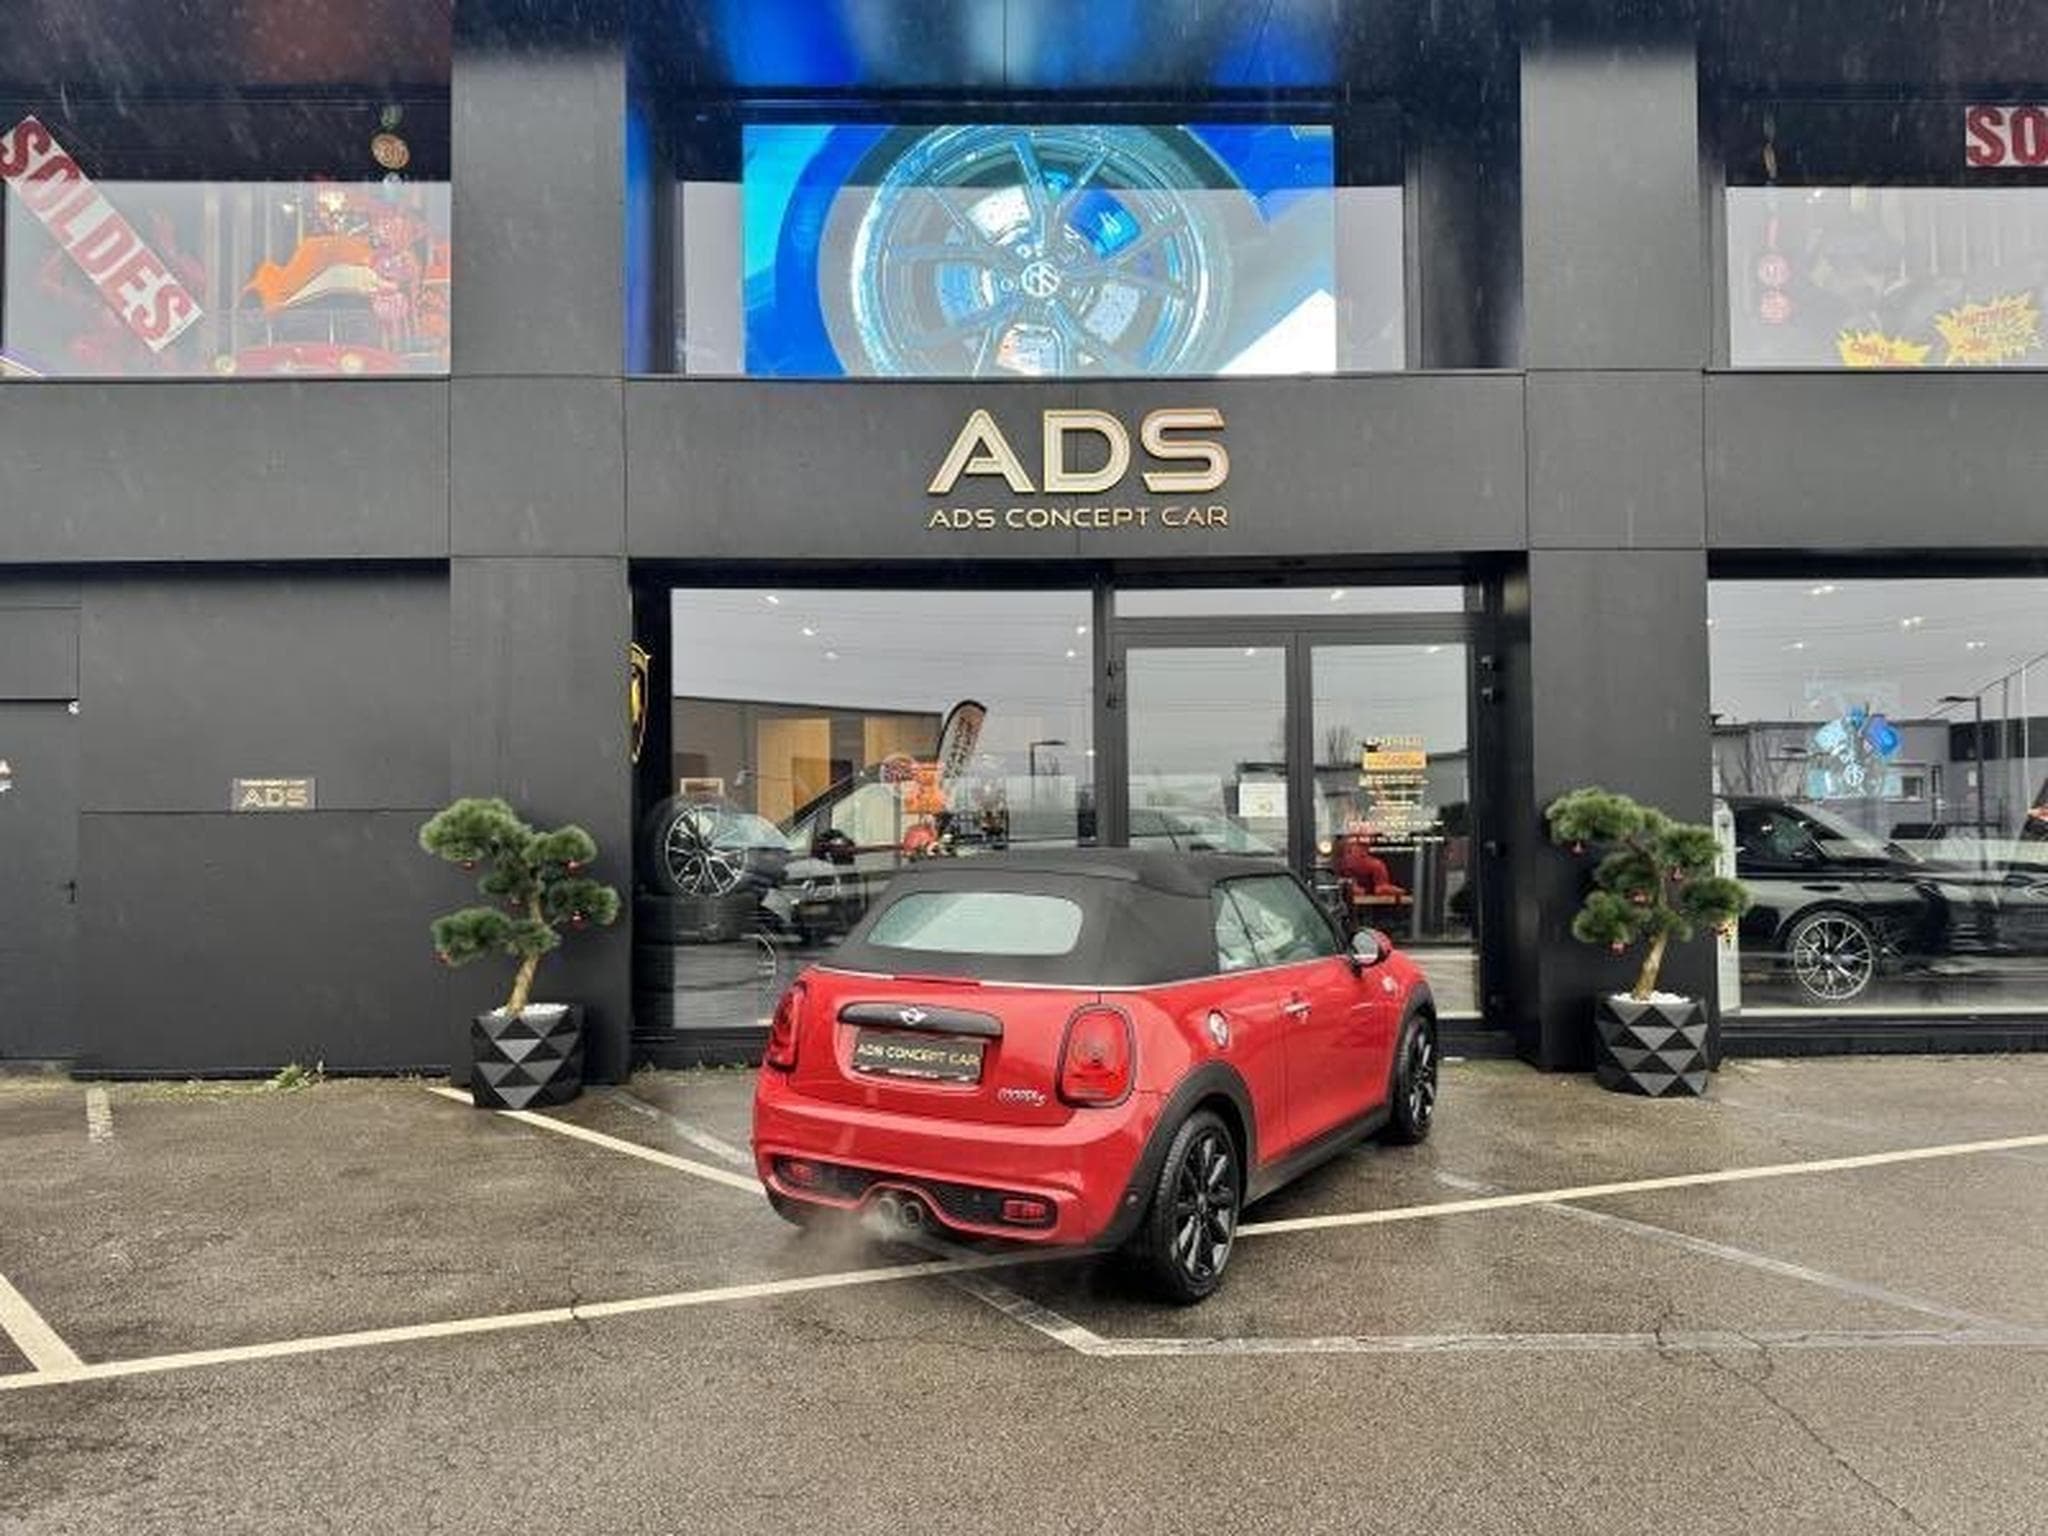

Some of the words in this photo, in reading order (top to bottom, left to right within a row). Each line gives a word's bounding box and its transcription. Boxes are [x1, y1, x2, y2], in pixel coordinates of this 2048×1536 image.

[0, 119, 193, 342] SOLDES
[928, 408, 1230, 492] ADS
[928, 508, 995, 528] ADS
[1005, 508, 1149, 528] CONCEPT
[1162, 506, 1229, 526] CAR
[240, 788, 308, 807] ADS
[886, 1046, 946, 1063] CONCEPT
[949, 1053, 981, 1066] CAR
